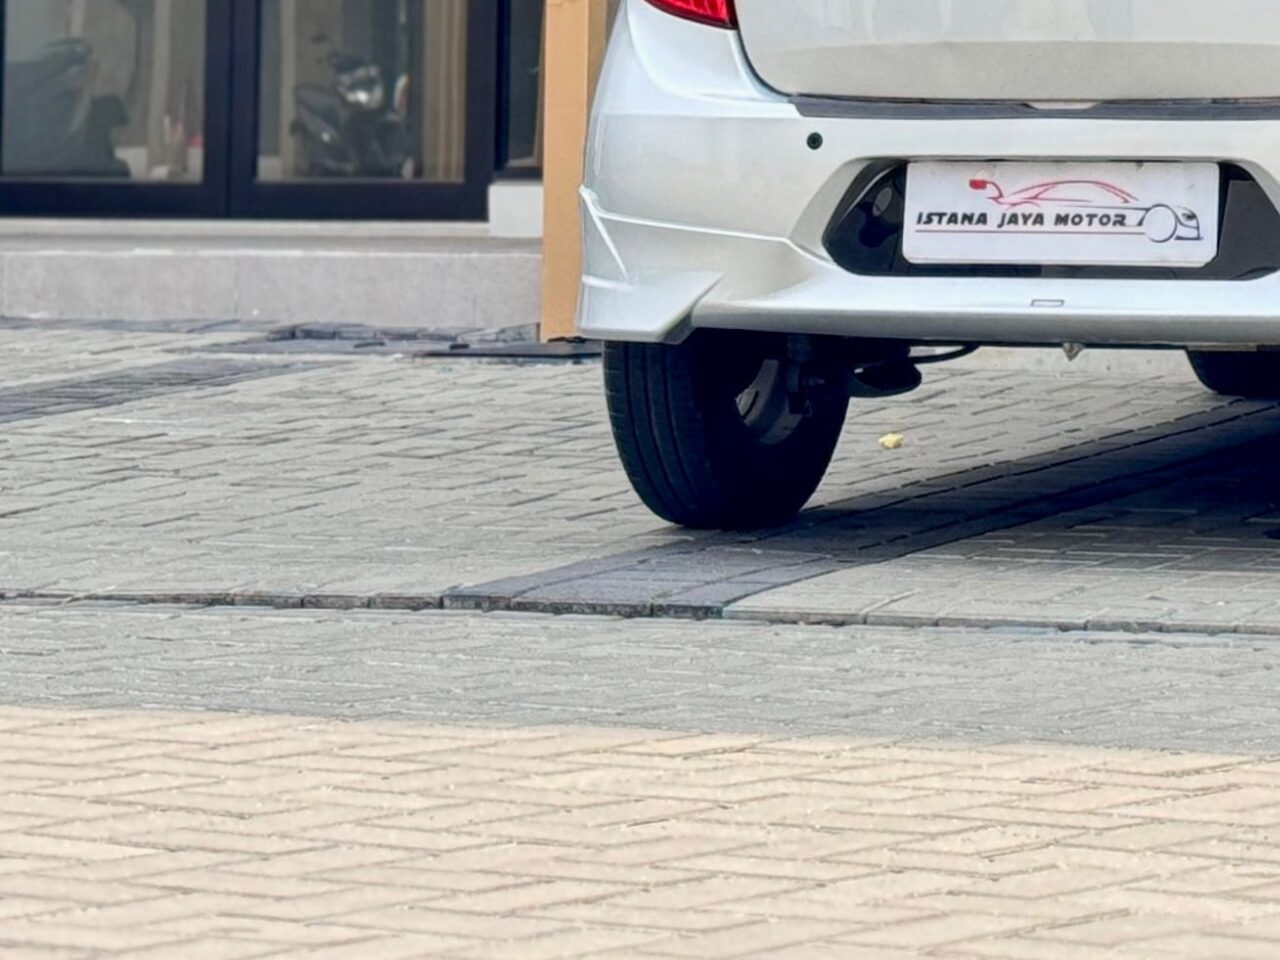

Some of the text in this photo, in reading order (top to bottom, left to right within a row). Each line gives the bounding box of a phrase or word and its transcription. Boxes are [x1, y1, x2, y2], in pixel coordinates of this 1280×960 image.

[915, 211, 1128, 229] ISTANA JAYA MOTOR
